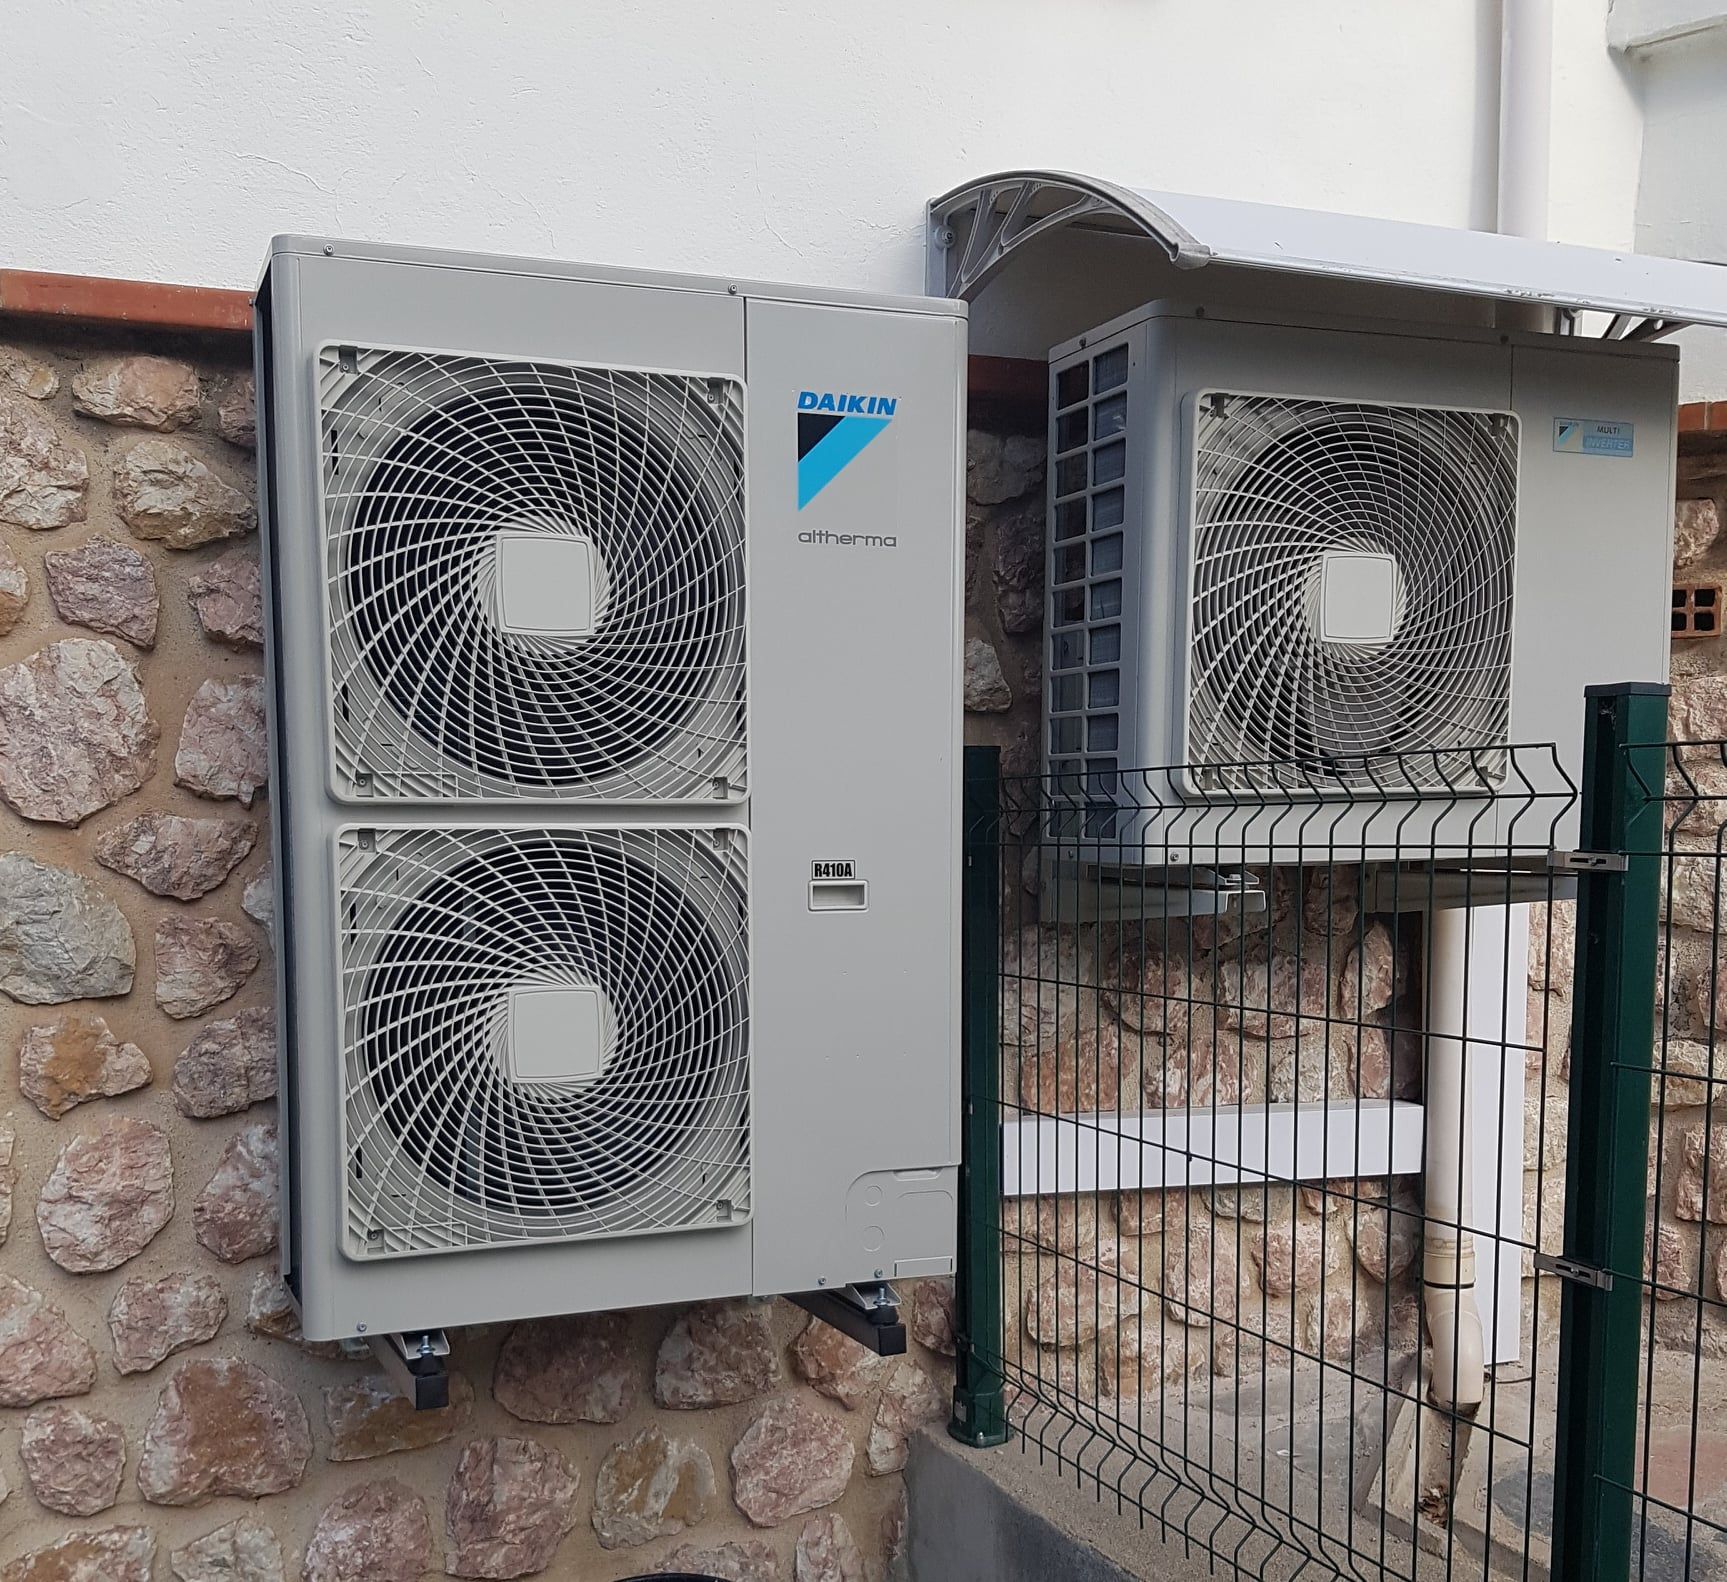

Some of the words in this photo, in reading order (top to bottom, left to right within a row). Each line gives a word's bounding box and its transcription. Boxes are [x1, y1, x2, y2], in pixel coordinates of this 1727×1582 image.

[798, 391, 897, 416] DAIKIN
[1596, 425, 1620, 434] MULTI
[798, 529, 897, 547] altherma
[814, 862, 852, 877] R410A
